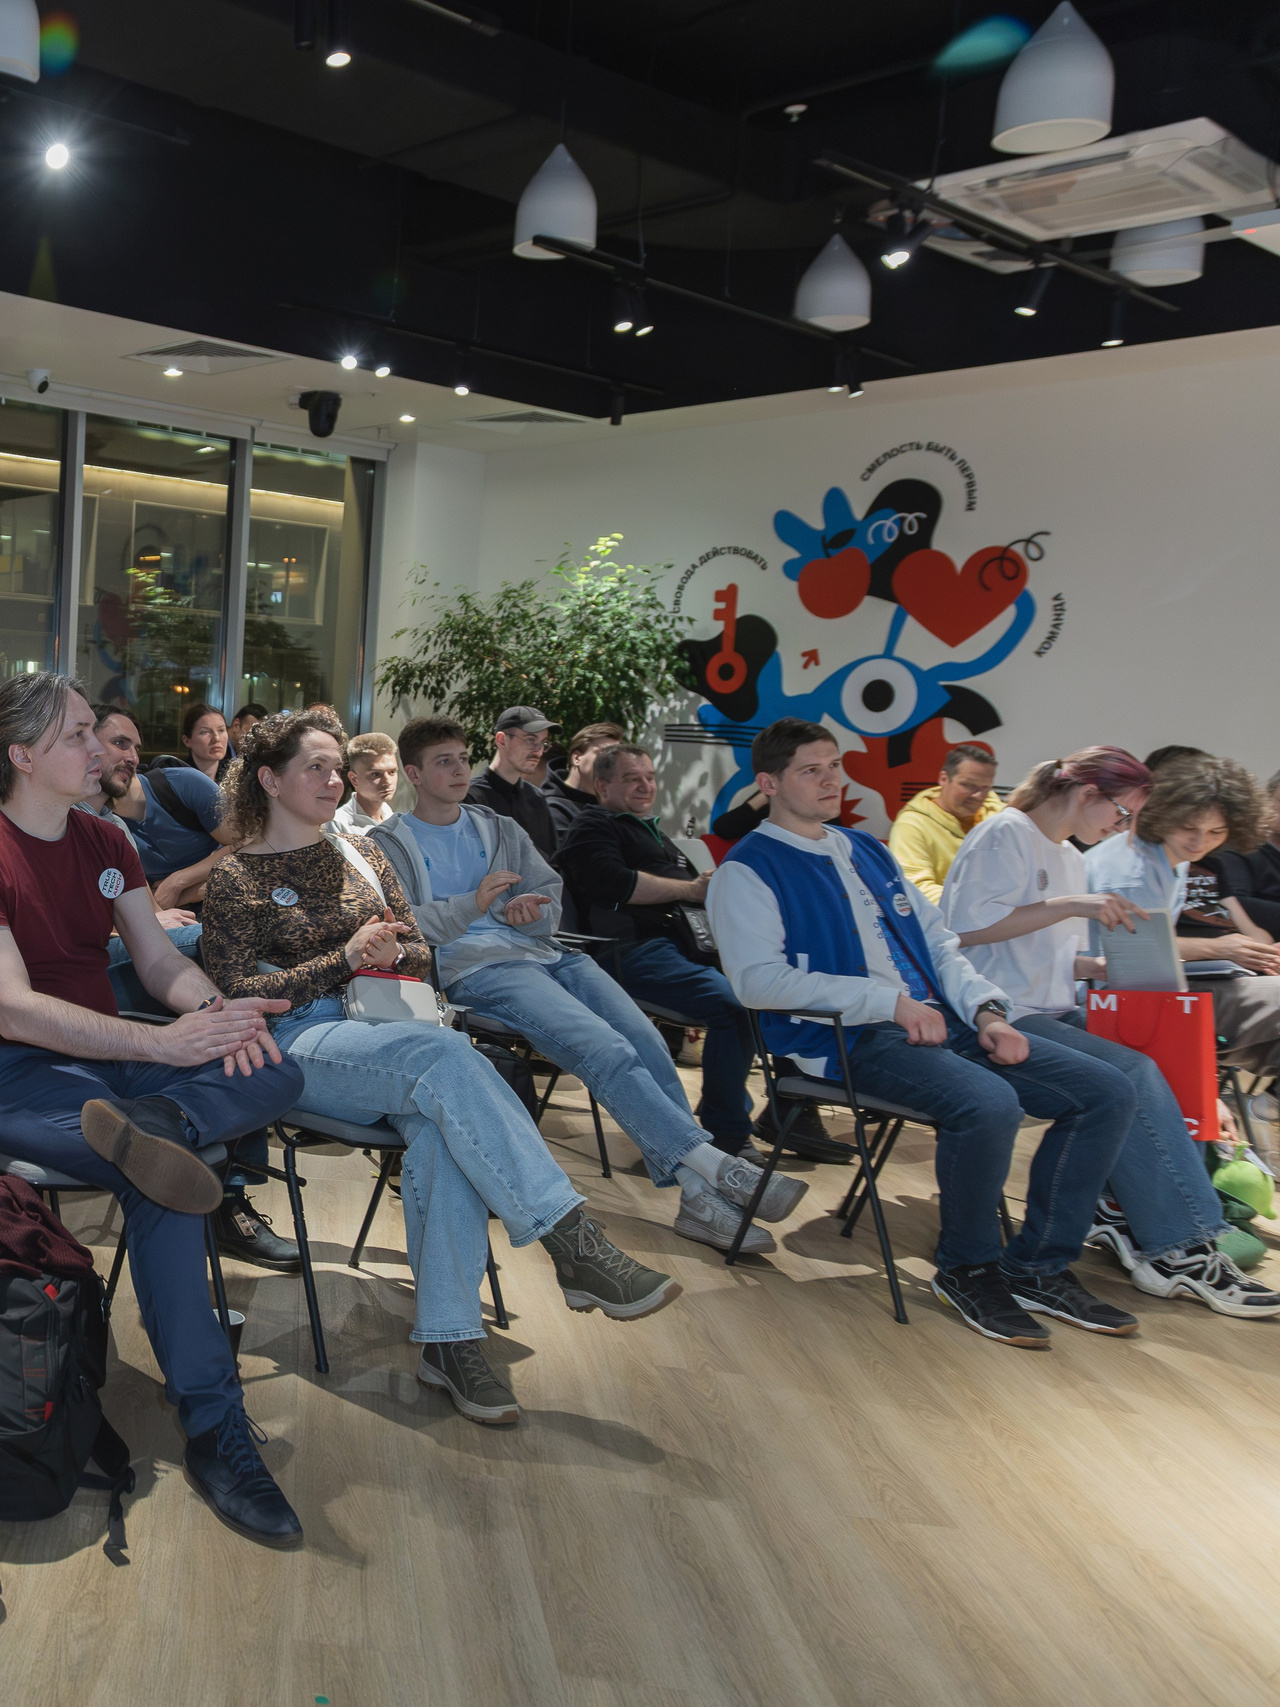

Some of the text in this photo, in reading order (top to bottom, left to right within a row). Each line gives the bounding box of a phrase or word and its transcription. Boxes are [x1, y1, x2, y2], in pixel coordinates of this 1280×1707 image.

[860, 441, 978, 512] СМЕЛОСТЬ БЫТЬ ПЕРВЫМ
[673, 546, 768, 614] СВОБОДА ДЕЙСТВОВАТЬ
[1033, 592, 1067, 658] КОМАНДА
[102, 870, 111, 892] TRUE
[107, 872, 117, 893] TECH
[113, 874, 122, 896] ARCH
